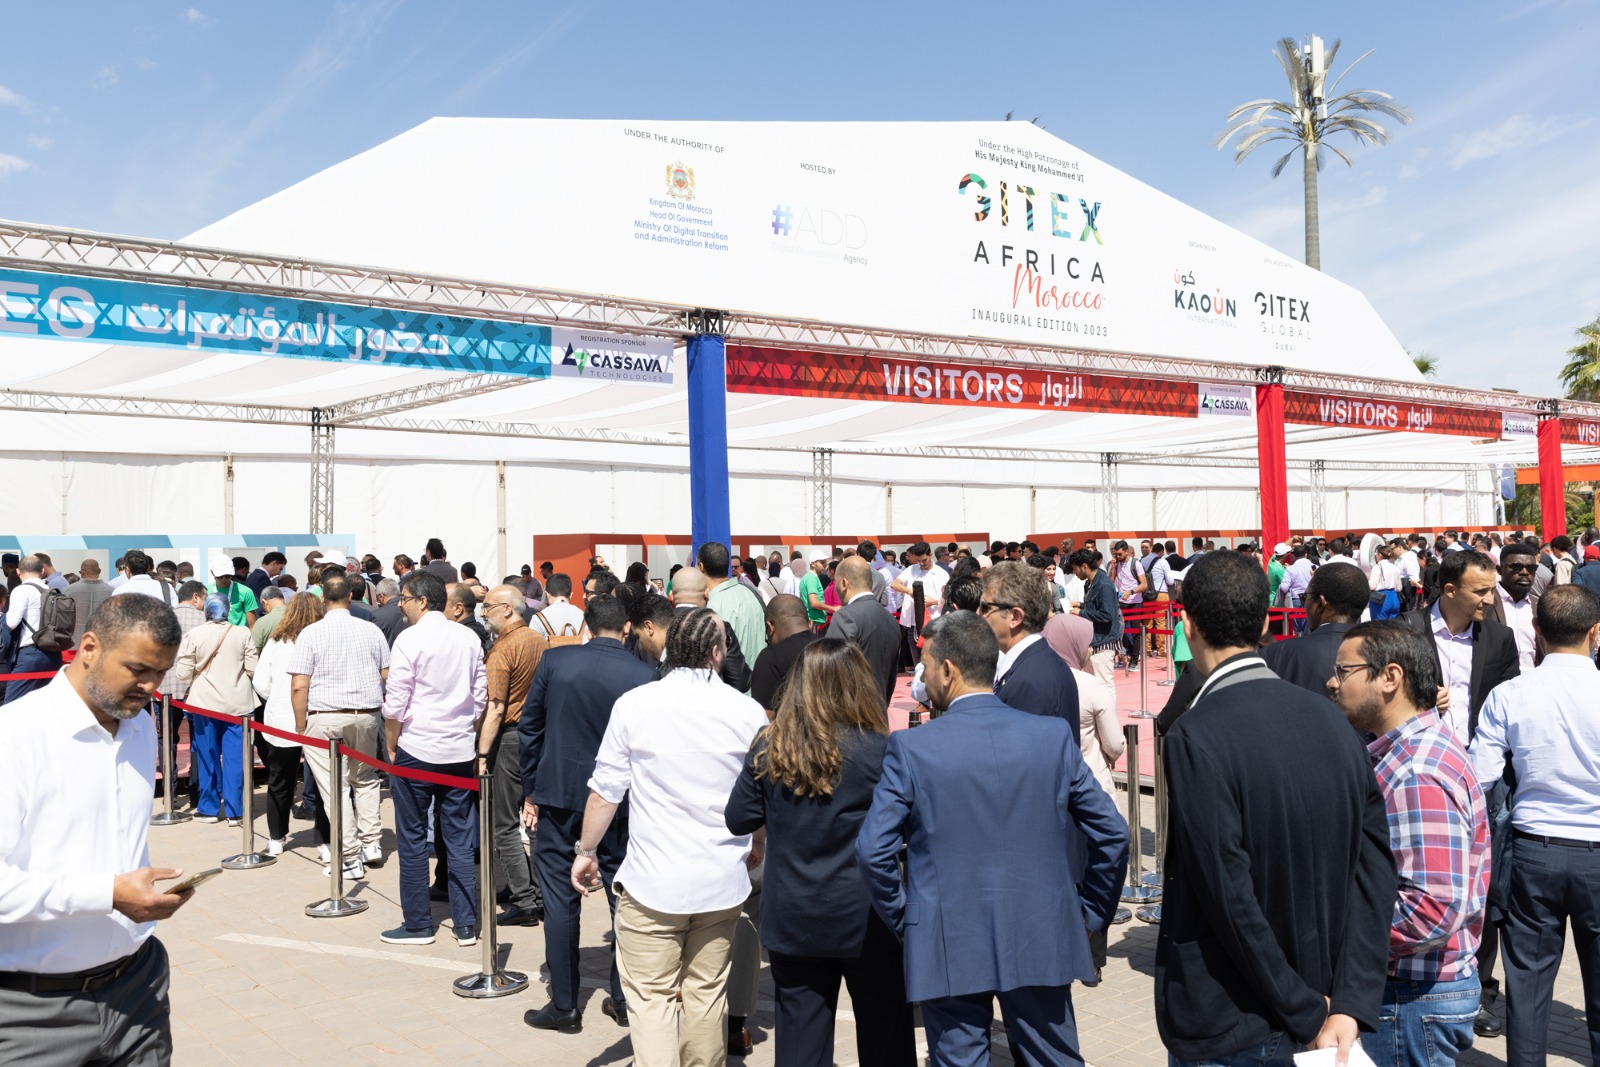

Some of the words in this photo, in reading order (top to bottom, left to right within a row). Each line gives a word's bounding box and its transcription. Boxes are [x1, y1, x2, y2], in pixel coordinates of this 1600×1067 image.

[624, 128, 651, 140] UNDER
[653, 133, 668, 143] THE
[671, 137, 713, 151] AUTHORITY
[715, 145, 725, 154] OF
[975, 149, 987, 160] His
[989, 153, 1018, 168] Majesty
[1020, 160, 1036, 173] King
[1037, 164, 1075, 180] Mohammed
[1077, 174, 1084, 183] VI
[978, 138, 1001, 151] Under
[1003, 145, 1015, 154] the
[1017, 147, 1033, 159] High
[1034, 151, 1070, 169] Patronage
[1072, 162, 1079, 170] of
[800, 162, 827, 174] HOSTED
[828, 167, 836, 175] BY
[649, 198, 676, 208] Kingdom
[677, 202, 685, 210] Of
[686, 203, 713, 215] Morocco
[650, 210, 667, 220] Head
[668, 212, 675, 221] Of
[677, 214, 713, 226] Government
[958, 173, 1104, 245] GITEX
[634, 220, 661, 232] Ministry
[663, 224, 671, 232] Of
[673, 226, 696, 236] Digital
[697, 229, 728, 241] Transition
[634, 231, 650, 240] and
[651, 233, 703, 248] Administration
[704, 241, 729, 251] Reform
[843, 253, 868, 266] Agency
[973, 240, 1105, 284] AFRICA
[1012, 263, 1105, 310] Morocco
[1254, 291, 1310, 323] GITEX
[128, 300, 335, 354] المؤتمرات
[972, 308, 1032, 327] INAUGURAL
[1036, 317, 1079, 333] EDITION
[1083, 323, 1108, 337] 2023
[1187, 314, 1237, 328] INTERNATIONAL
[1260, 321, 1311, 340] GLOBAL
[349, 321, 449, 363] حضور
[580, 335, 620, 344] REGISTRATION
[621, 339, 647, 347] SPONSOR
[590, 353, 662, 373] CASSAVA
[590, 370, 663, 382] TECHNOLOGIES
[882, 363, 1024, 404] VISITORS
[1038, 374, 1083, 407] الزوار
[1214, 399, 1249, 411] CASSAVA
[1319, 398, 1398, 428] VISITORS
[1406, 406, 1432, 431] الزوار
